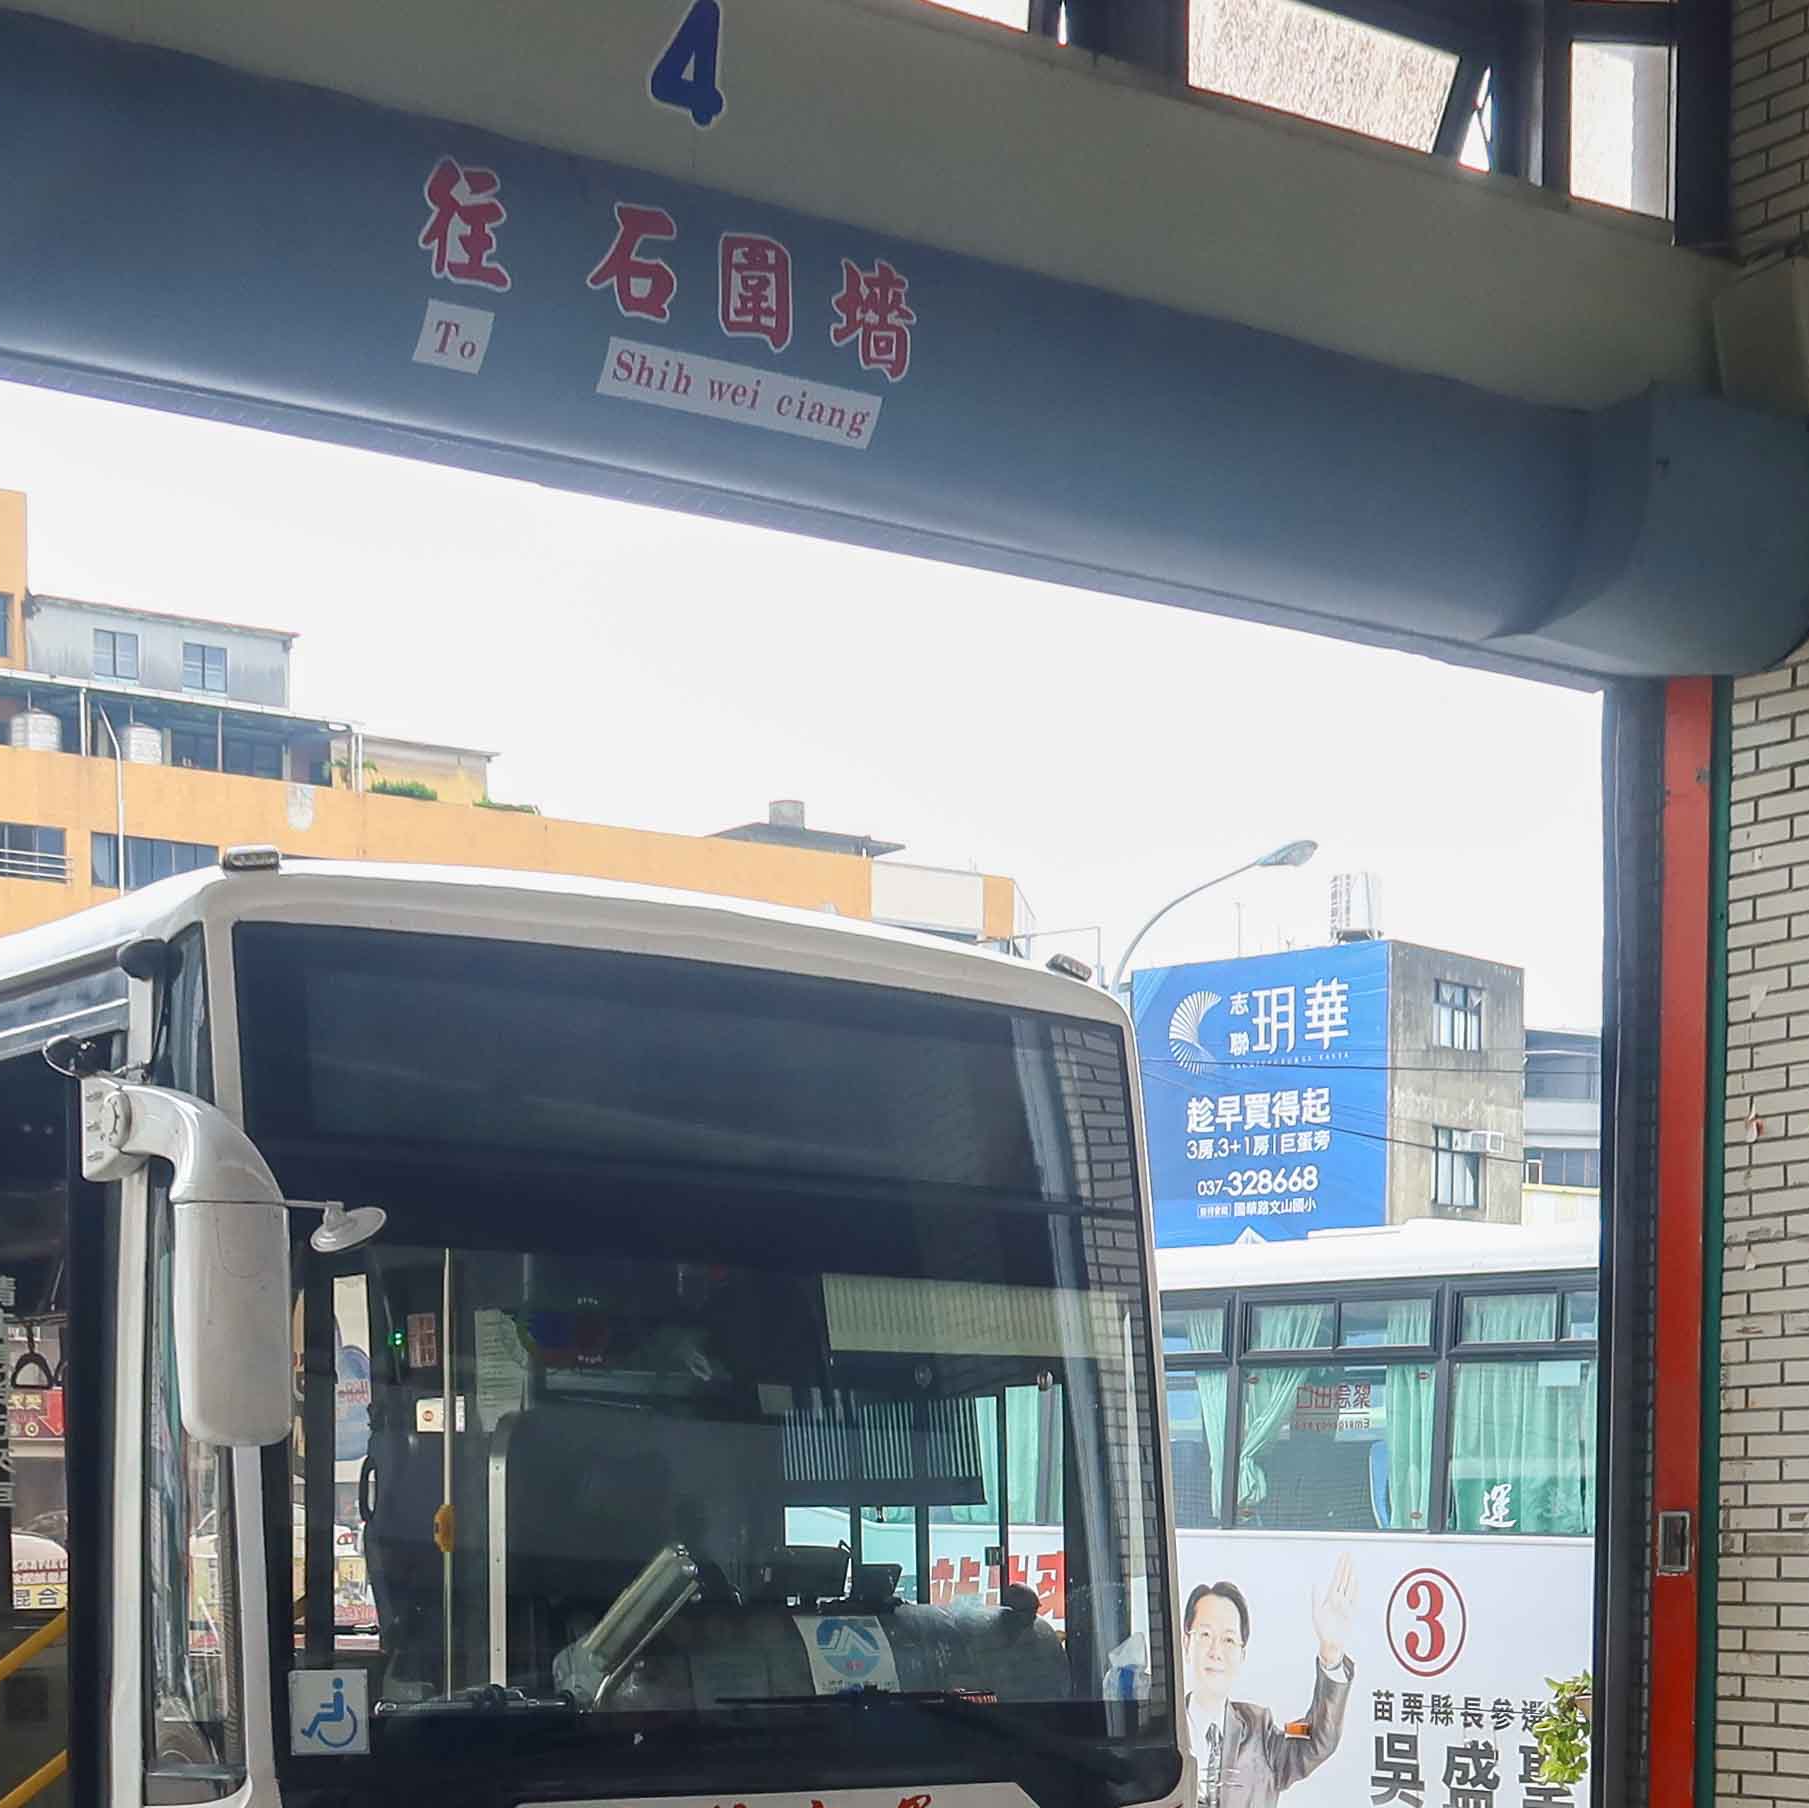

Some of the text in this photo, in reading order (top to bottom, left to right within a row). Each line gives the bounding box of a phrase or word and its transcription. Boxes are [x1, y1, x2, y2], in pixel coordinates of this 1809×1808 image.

[651, 0, 724, 127] 4
[418, 155, 511, 292] 往
[434, 320, 477, 360] To
[611, 348, 872, 438] Shih wei ciang
[1187, 1088, 1331, 1133] 趁早買得起
